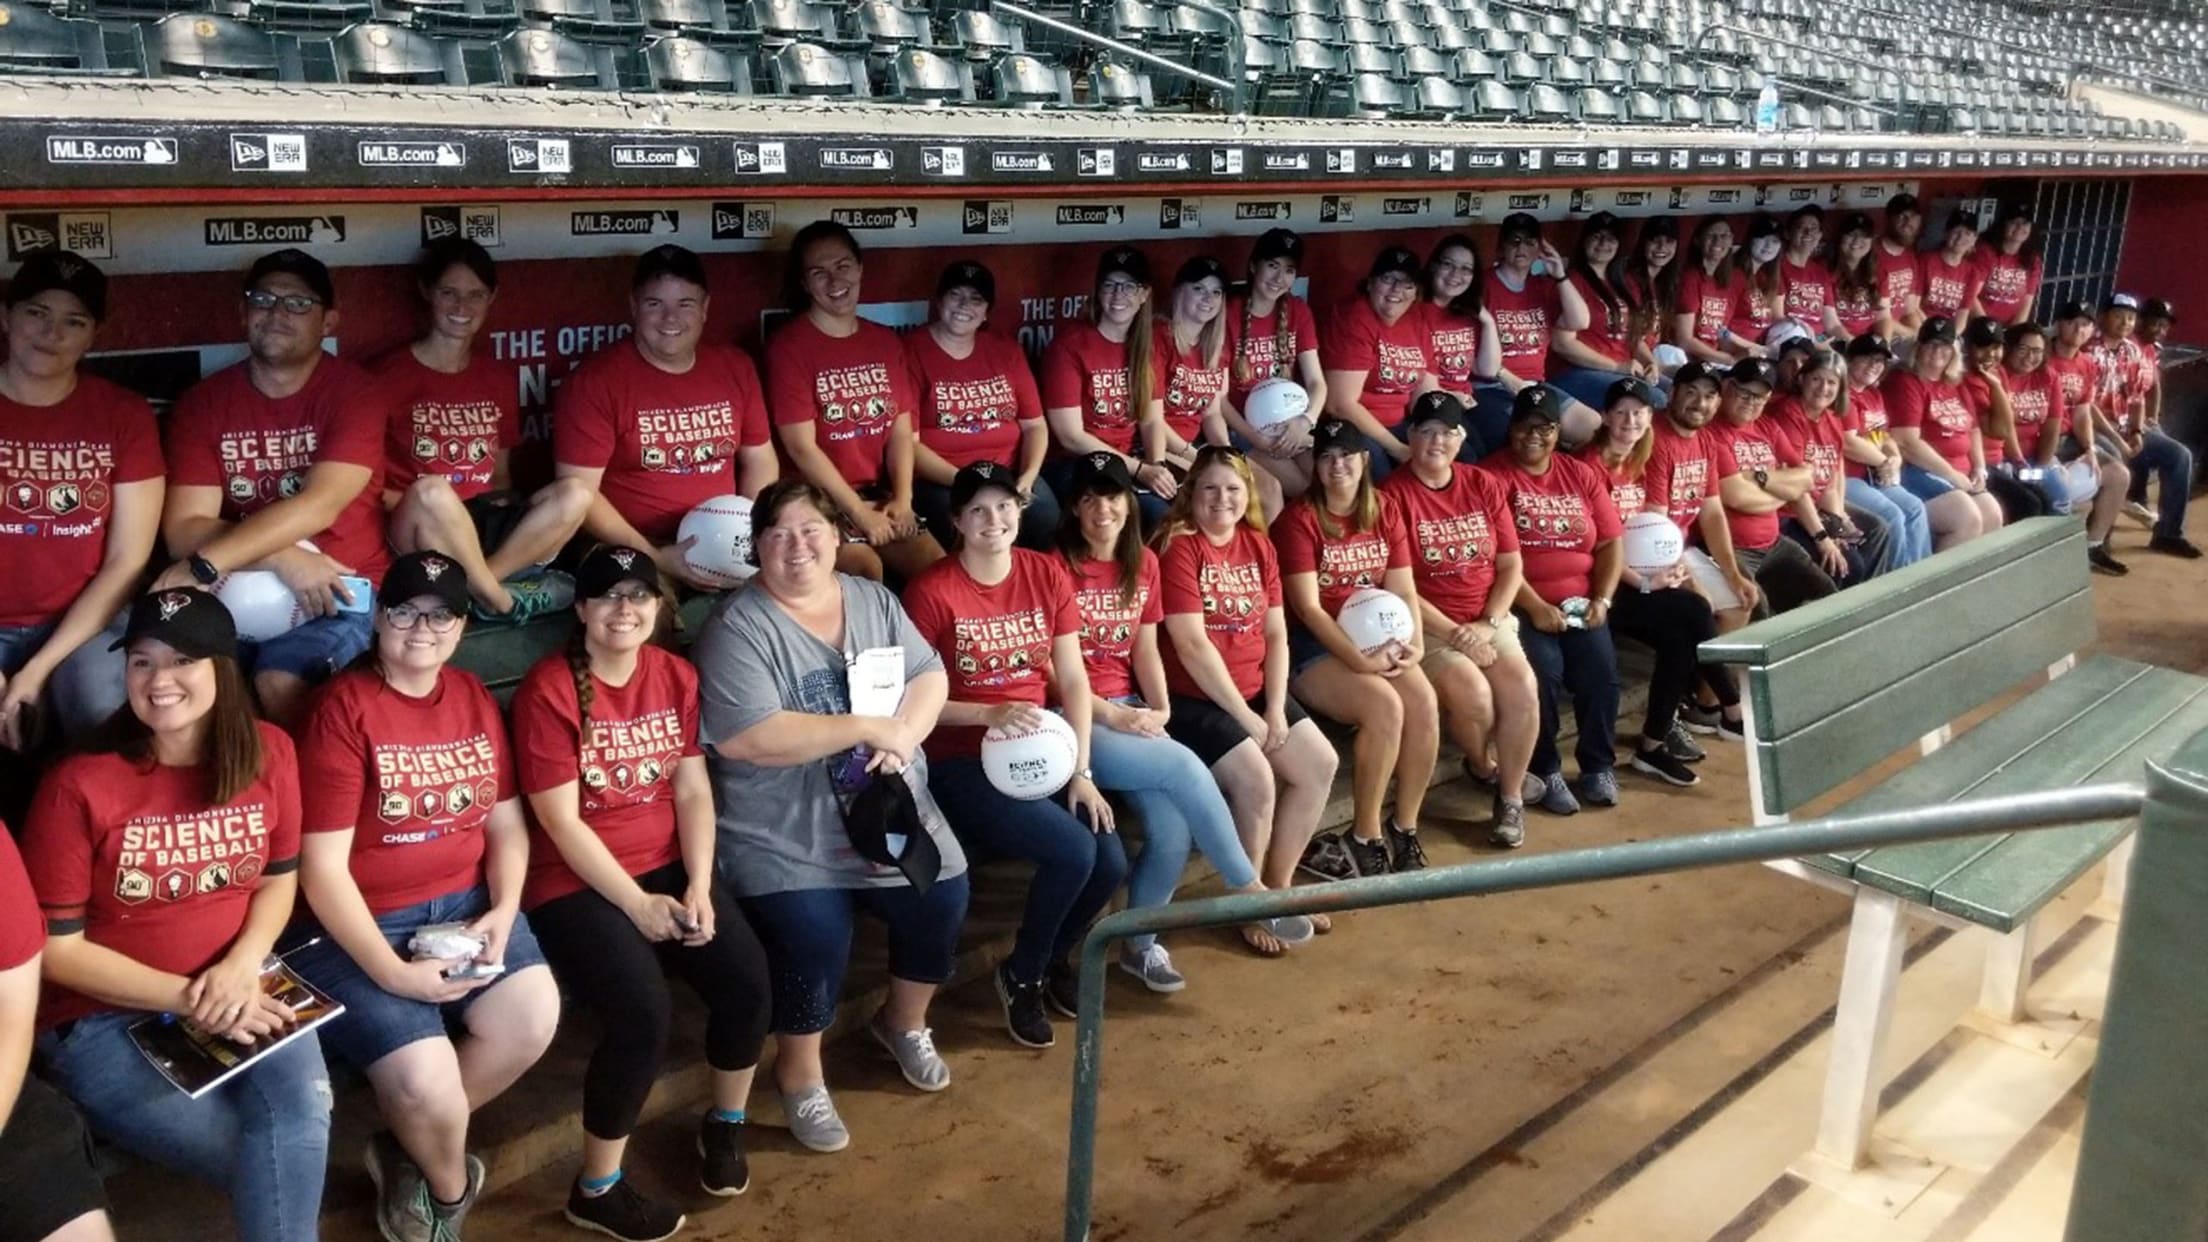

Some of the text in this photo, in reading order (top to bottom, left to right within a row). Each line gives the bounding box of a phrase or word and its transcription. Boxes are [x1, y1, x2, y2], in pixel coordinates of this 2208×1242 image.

[53, 140, 142, 160] MLB.com
[273, 142, 300, 153] NEW
[363, 145, 435, 162] MLB.com
[274, 153, 300, 163] ERA
[615, 150, 675, 164] MLB.com
[823, 150, 872, 165] MLB.com
[994, 153, 1038, 168] MLB.com
[466, 214, 494, 227] NEW
[574, 214, 650, 232] MLB.com
[833, 209, 894, 227] MLB.com
[1058, 207, 1106, 222] MLB.com
[66, 222, 105, 236] NEW
[208, 221, 308, 242] MLB.com
[467, 227, 494, 239] ERA
[67, 236, 105, 249] ERA
[1021, 295, 1088, 321] THE OF
[490, 323, 632, 360] THE OFFIC
[816, 368, 890, 394] SCIENCE
[1092, 373, 1127, 388] SCIE
[936, 379, 1012, 401] SCIENCE
[958, 393, 1017, 410] BASEBALL
[638, 407, 733, 433] SCIENCE
[440, 424, 498, 437] BASEBA
[640, 425, 736, 445] OF BASEBALL
[221, 432, 318, 460] SCENCE
[7, 468, 112, 481] BASEBAL
[224, 460, 247, 474] OF
[53, 523, 94, 538] Insight
[1322, 543, 1390, 563] SCIENCE
[1091, 609, 1141, 621] BASEBA
[955, 612, 1047, 642] SCIENCE
[956, 631, 1048, 653] OF BASEBALL
[583, 714, 682, 749] CIENCE
[376, 739, 496, 774] SCIENCE
[604, 735, 686, 762] BASEBALL
[379, 759, 497, 790] OF BASEBALL
[122, 811, 267, 851] SCIENCE
[382, 830, 427, 844] CHASE
[118, 850, 148, 867] OF
